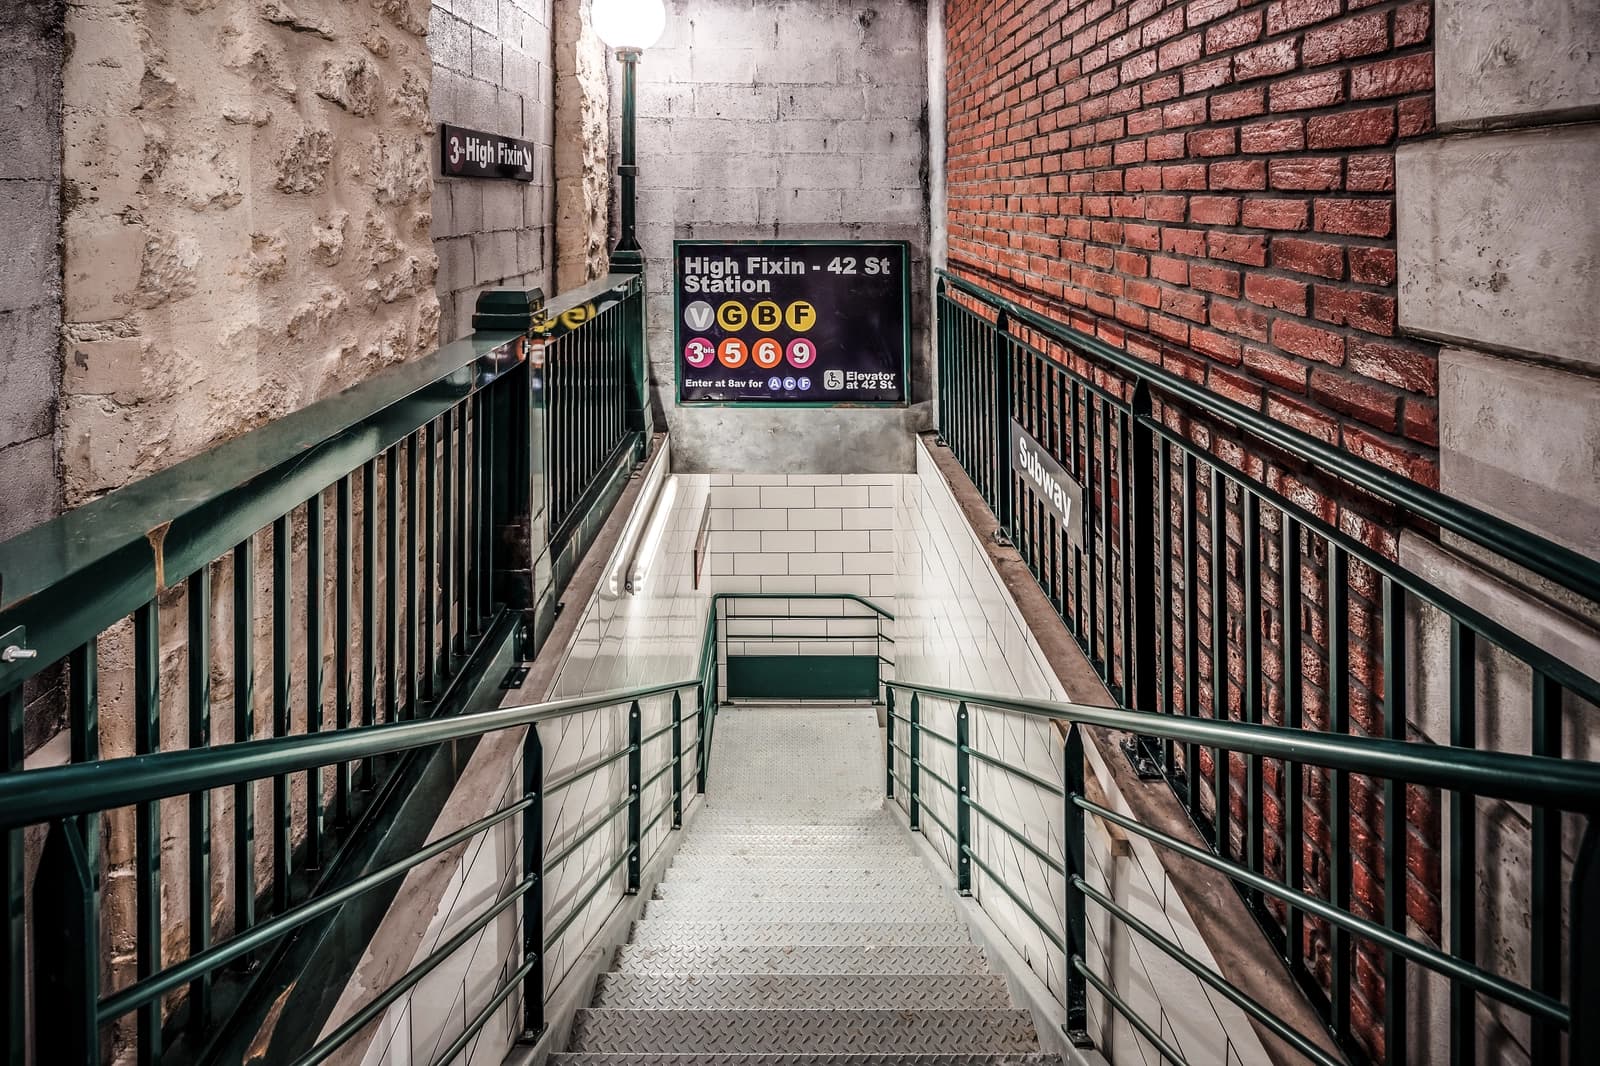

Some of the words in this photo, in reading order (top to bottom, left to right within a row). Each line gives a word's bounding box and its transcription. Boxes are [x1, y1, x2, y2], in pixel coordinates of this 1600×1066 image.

[465, 137, 495, 169] High
[497, 142, 523, 166] Fixin
[684, 257, 739, 279] High
[747, 257, 805, 275] Fixin
[827, 257, 857, 275] 42
[864, 257, 891, 275] St
[684, 275, 771, 293] Station
[689, 307, 710, 328] V
[722, 305, 742, 325] G
[758, 306, 777, 325] B
[794, 304, 810, 325] F
[724, 342, 742, 363] 5
[758, 342, 776, 364] 6
[792, 342, 810, 364] 9
[685, 379, 713, 388] Enter
[715, 379, 726, 388] at
[728, 379, 746, 388] 8av
[748, 379, 764, 388] for
[770, 379, 781, 388] A
[784, 379, 795, 388] C
[846, 371, 896, 381] Elevator
[846, 380, 858, 390] at
[861, 380, 877, 390] 42
[879, 380, 897, 390] St.
[1019, 436, 1072, 528] Subway
